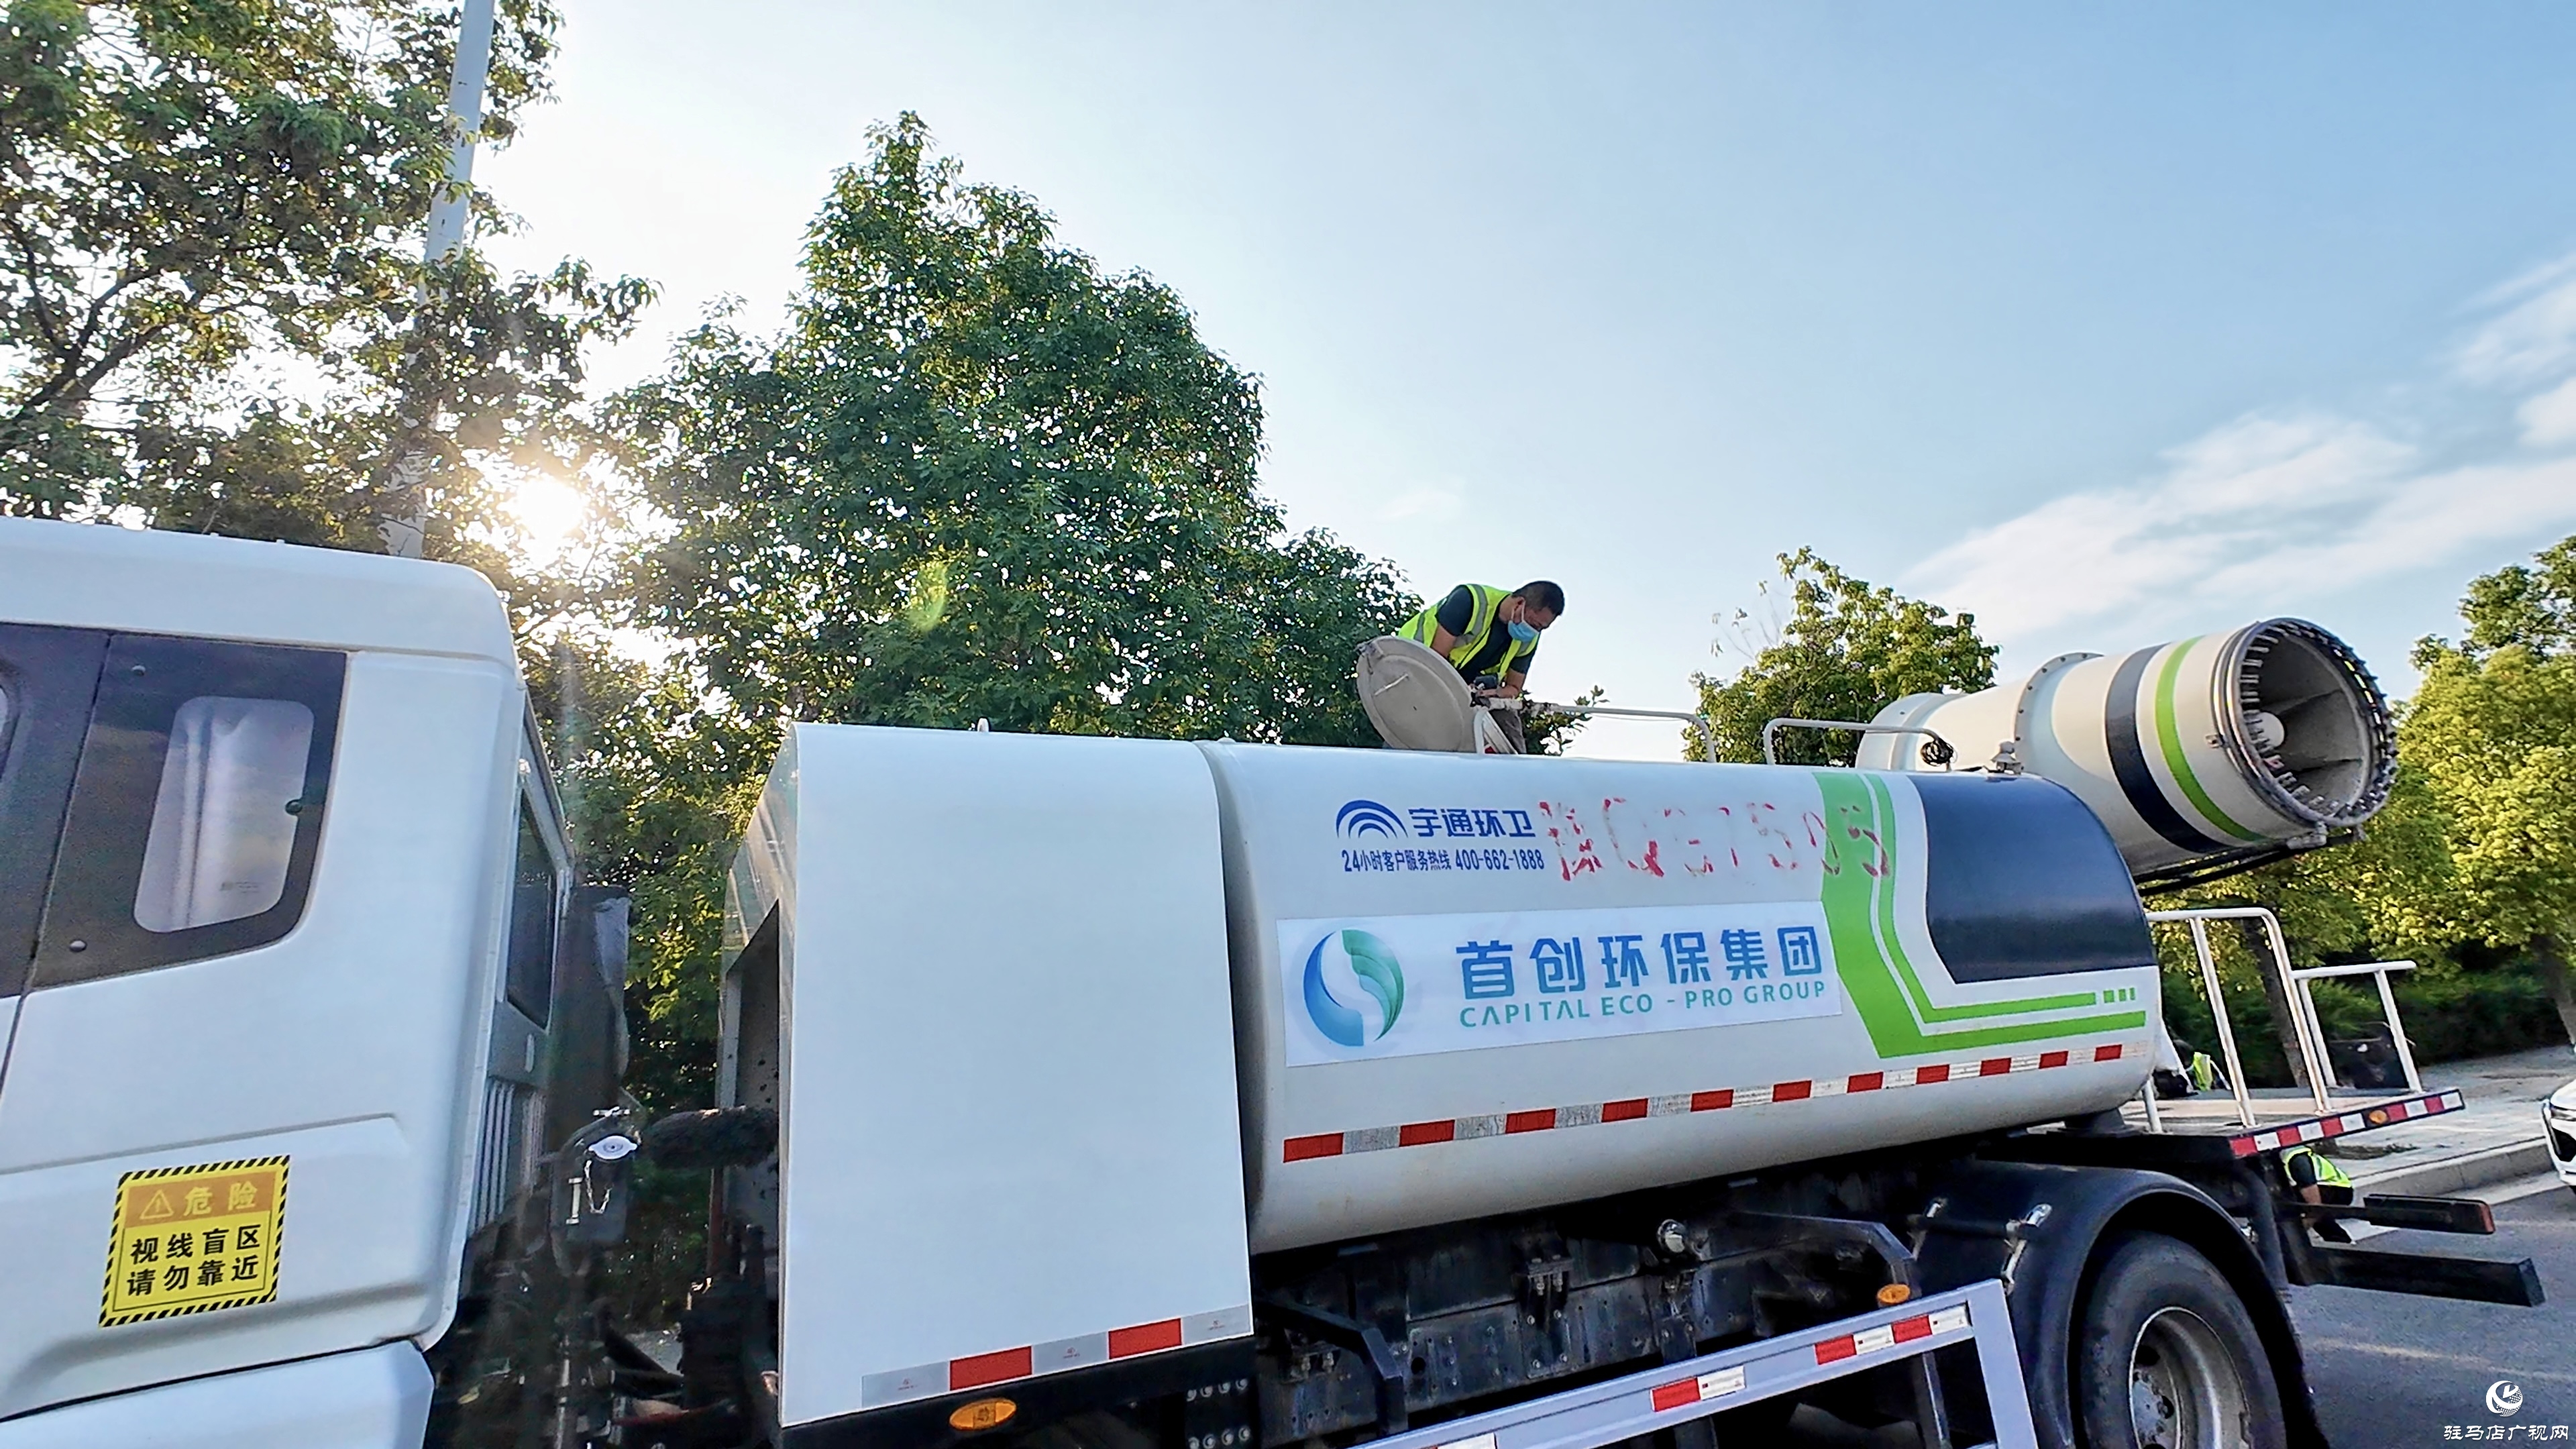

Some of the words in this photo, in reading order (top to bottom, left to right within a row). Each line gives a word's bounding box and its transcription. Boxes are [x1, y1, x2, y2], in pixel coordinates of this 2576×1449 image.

[1407, 808, 1536, 837] 宇通环卫
[1341, 849, 1452, 872] 24小时客户服务热线
[1455, 848, 1545, 871] 400-662-1888
[1456, 925, 1823, 1000] 首创环保集团
[1459, 998, 1591, 1028] CAPITAL
[1601, 993, 1654, 1016] ECO
[1686, 987, 1733, 1009] PRO
[1743, 980, 1826, 1004] GROUP
[183, 1181, 258, 1217] 危险
[130, 1224, 262, 1265] 视线盲区
[126, 1254, 259, 1297] 请勿靠近
